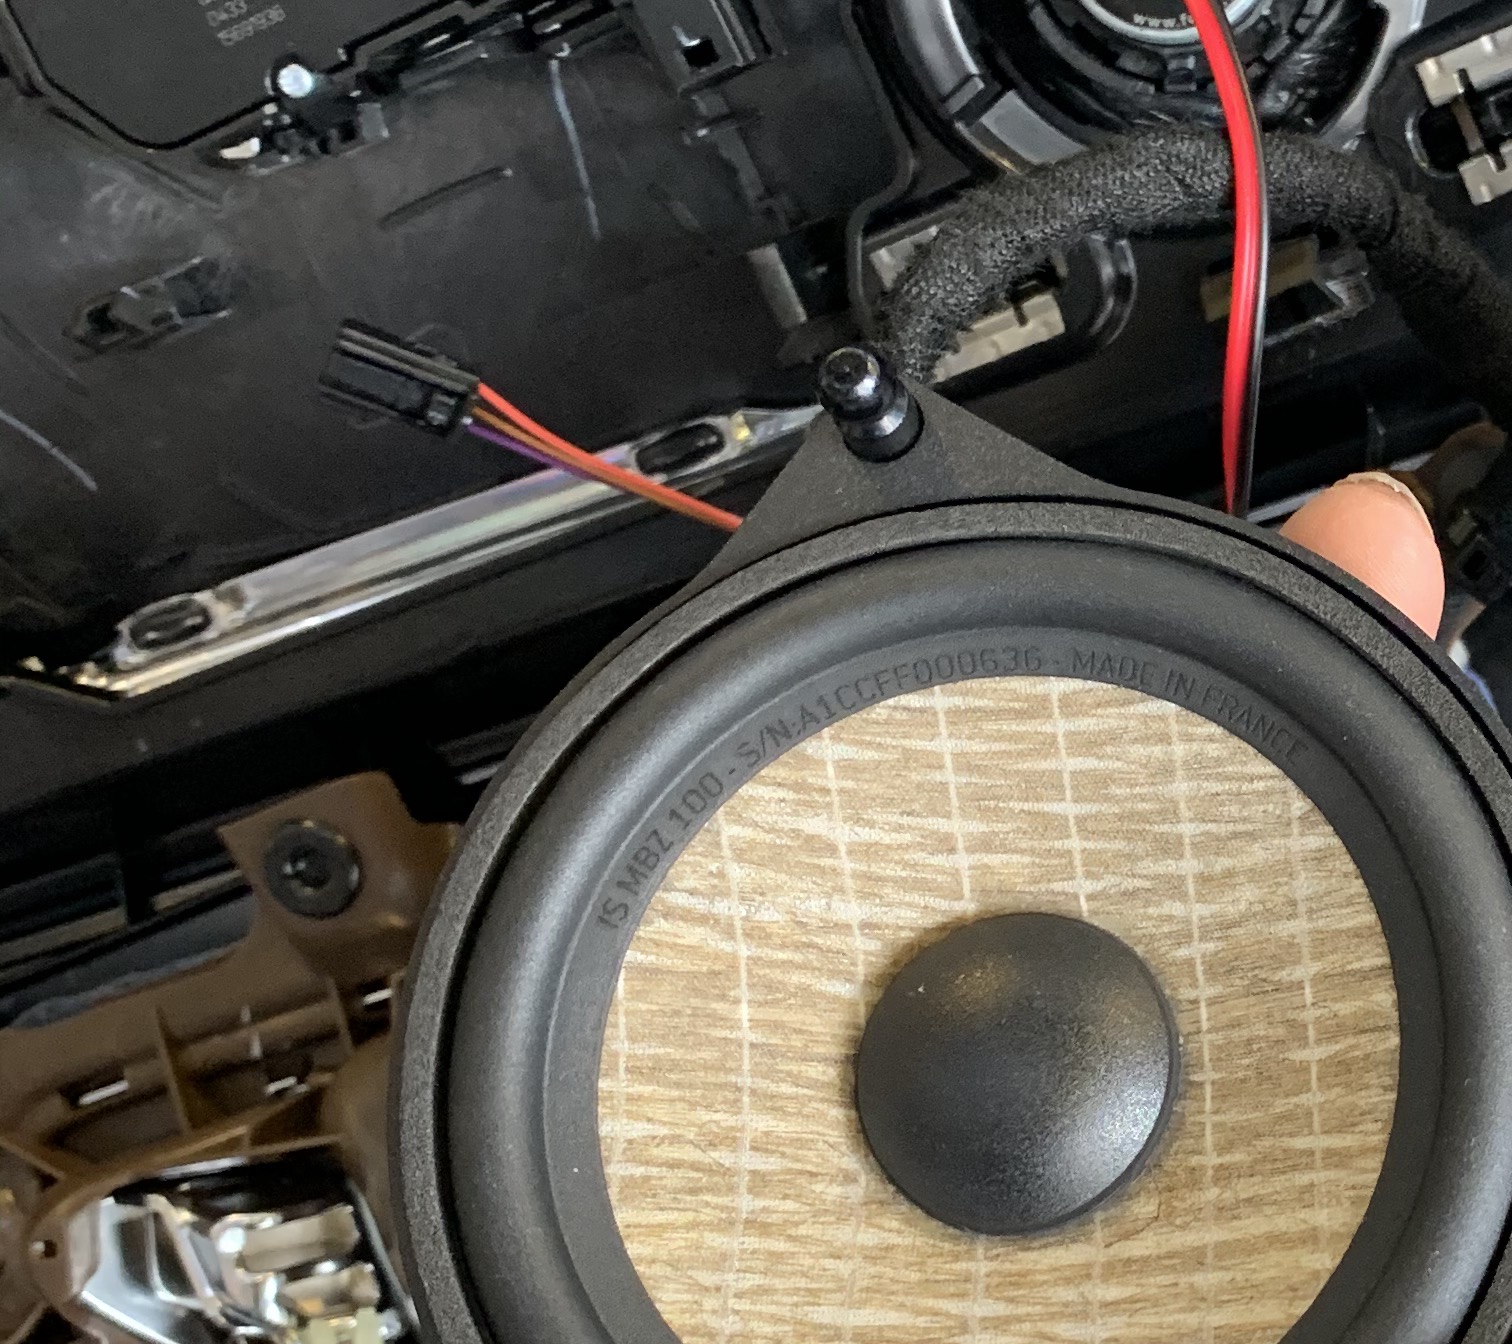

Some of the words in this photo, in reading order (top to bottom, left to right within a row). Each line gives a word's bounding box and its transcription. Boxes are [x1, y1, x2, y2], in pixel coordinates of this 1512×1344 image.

[616, 828, 675, 897] MBZ
[669, 771, 724, 832] 100
[1071, 646, 1157, 686] MADE
[1165, 668, 1197, 700] IN
[1201, 686, 1309, 766] FRANCE
